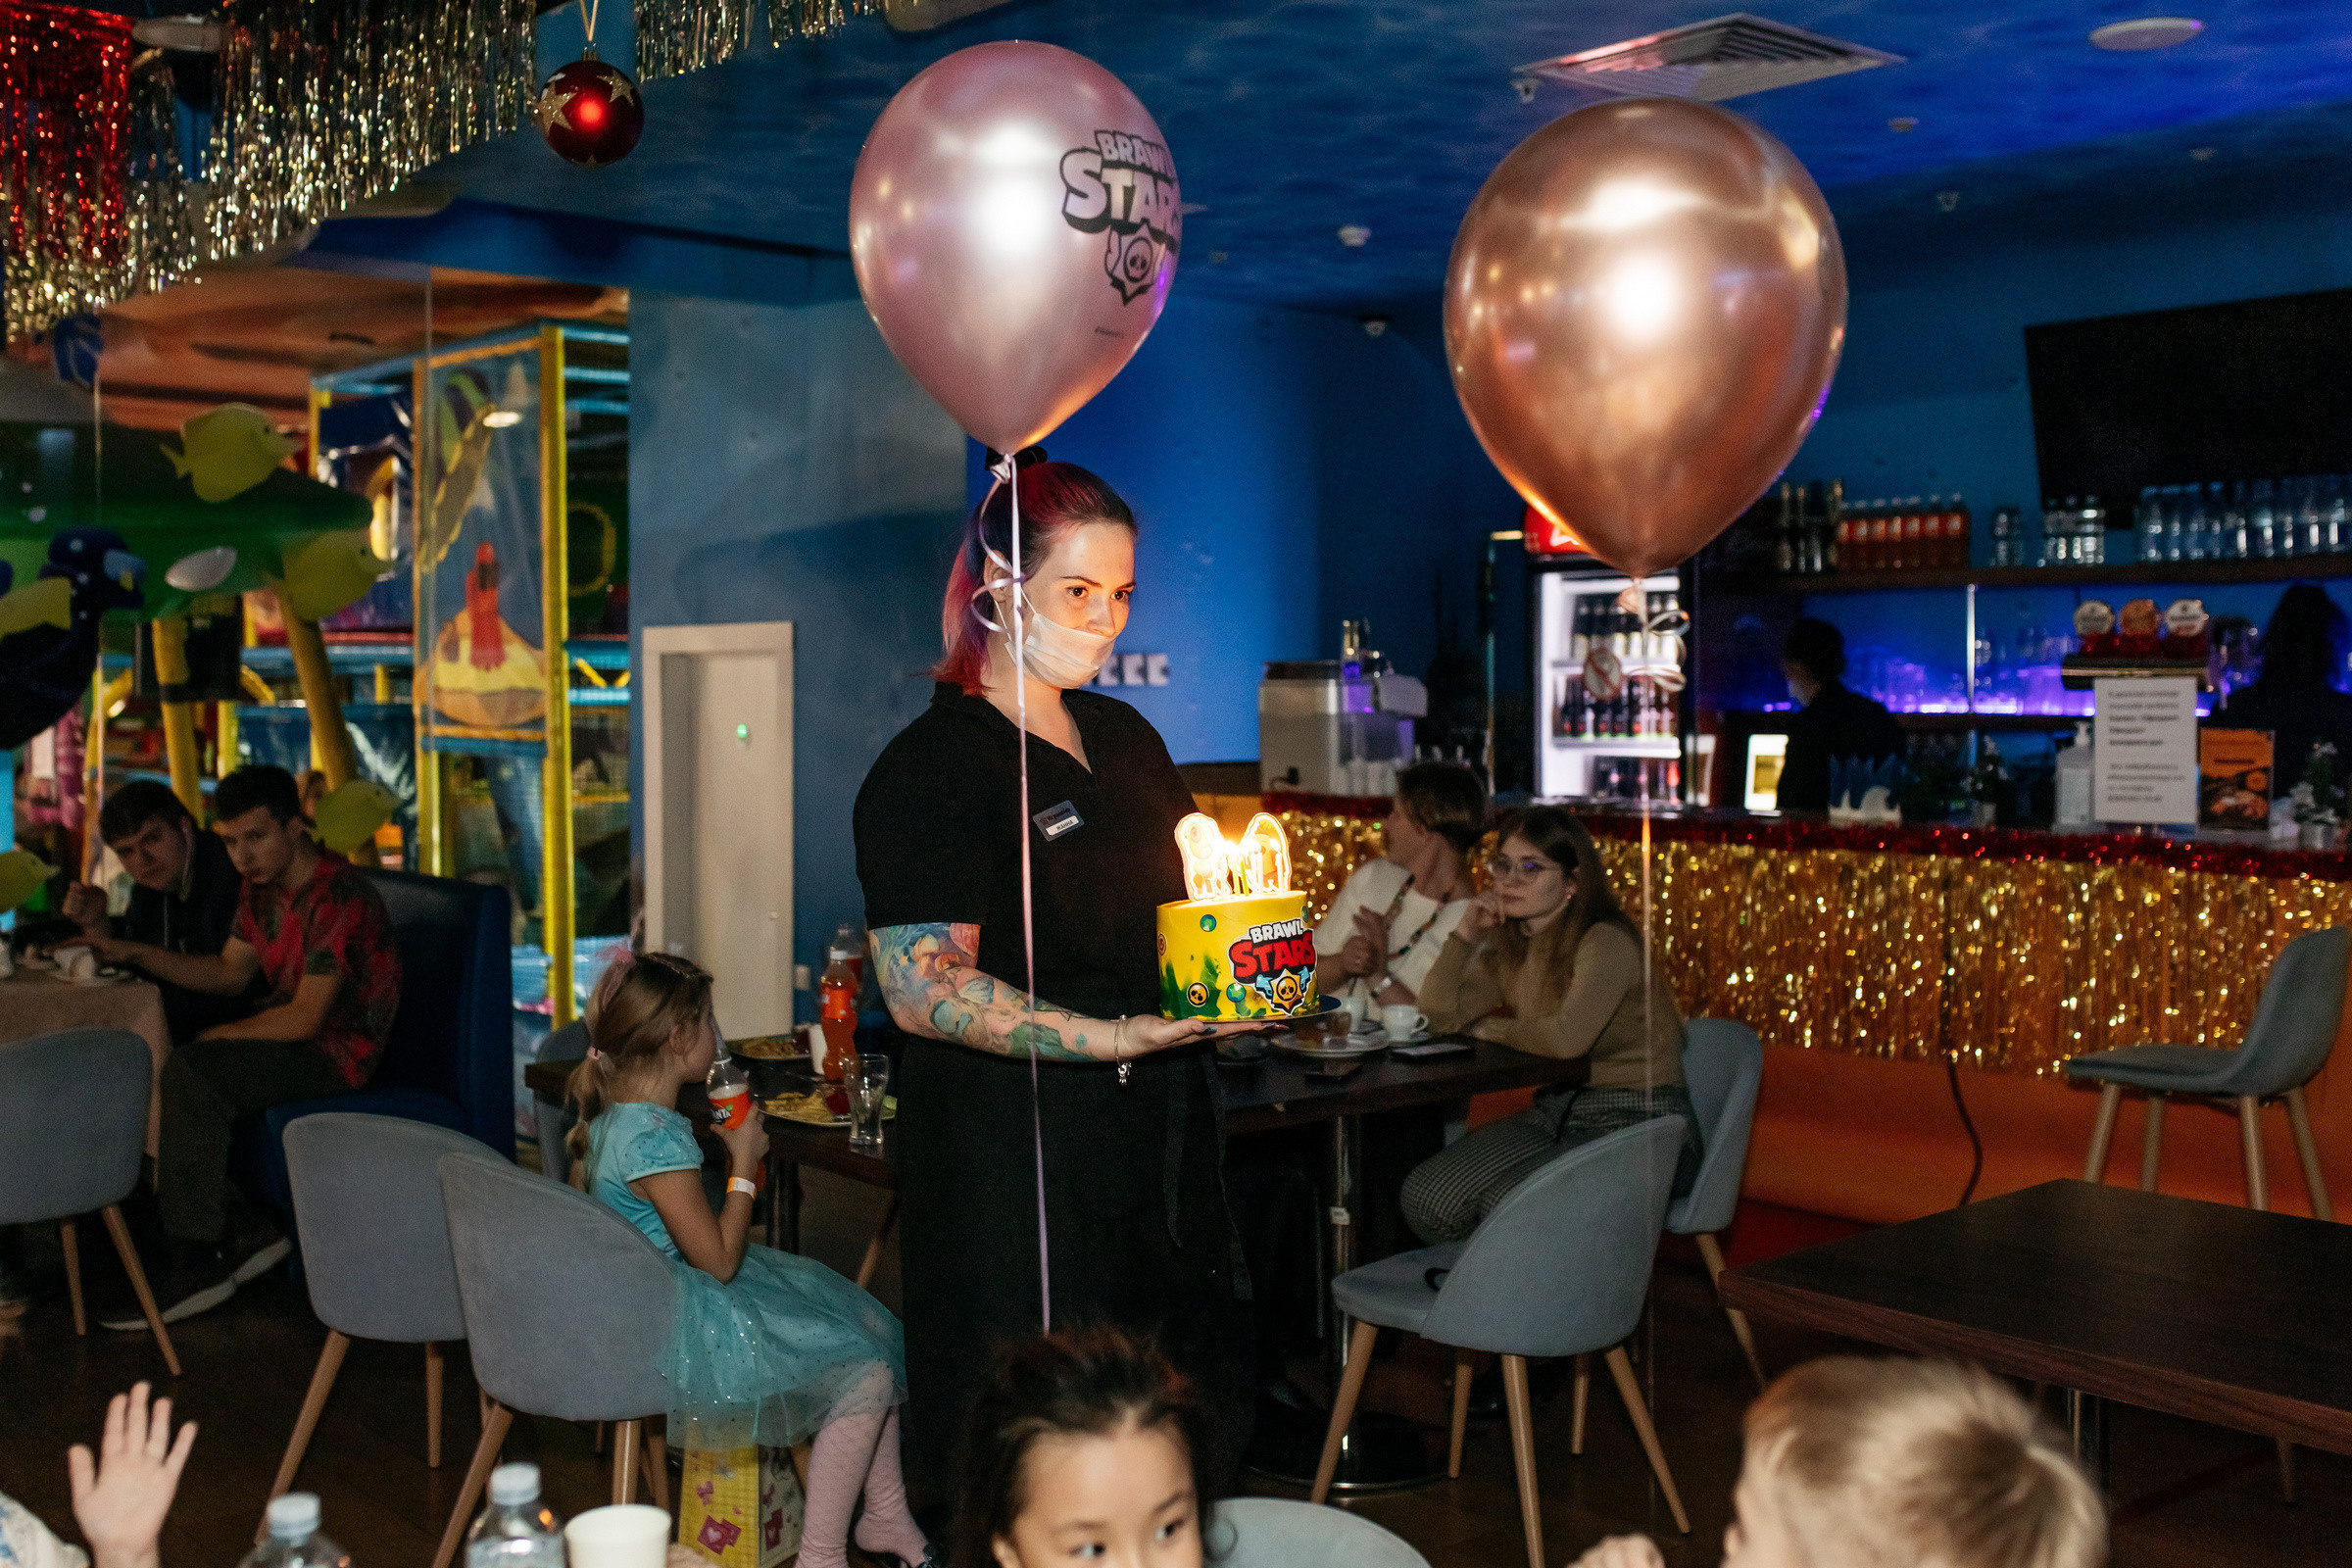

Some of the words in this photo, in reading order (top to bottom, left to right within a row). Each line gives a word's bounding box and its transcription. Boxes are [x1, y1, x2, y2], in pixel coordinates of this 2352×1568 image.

[1060, 146, 1181, 241] STAR
[1230, 930, 1316, 978] STARS
[1250, 919, 1303, 944] BRAWL
